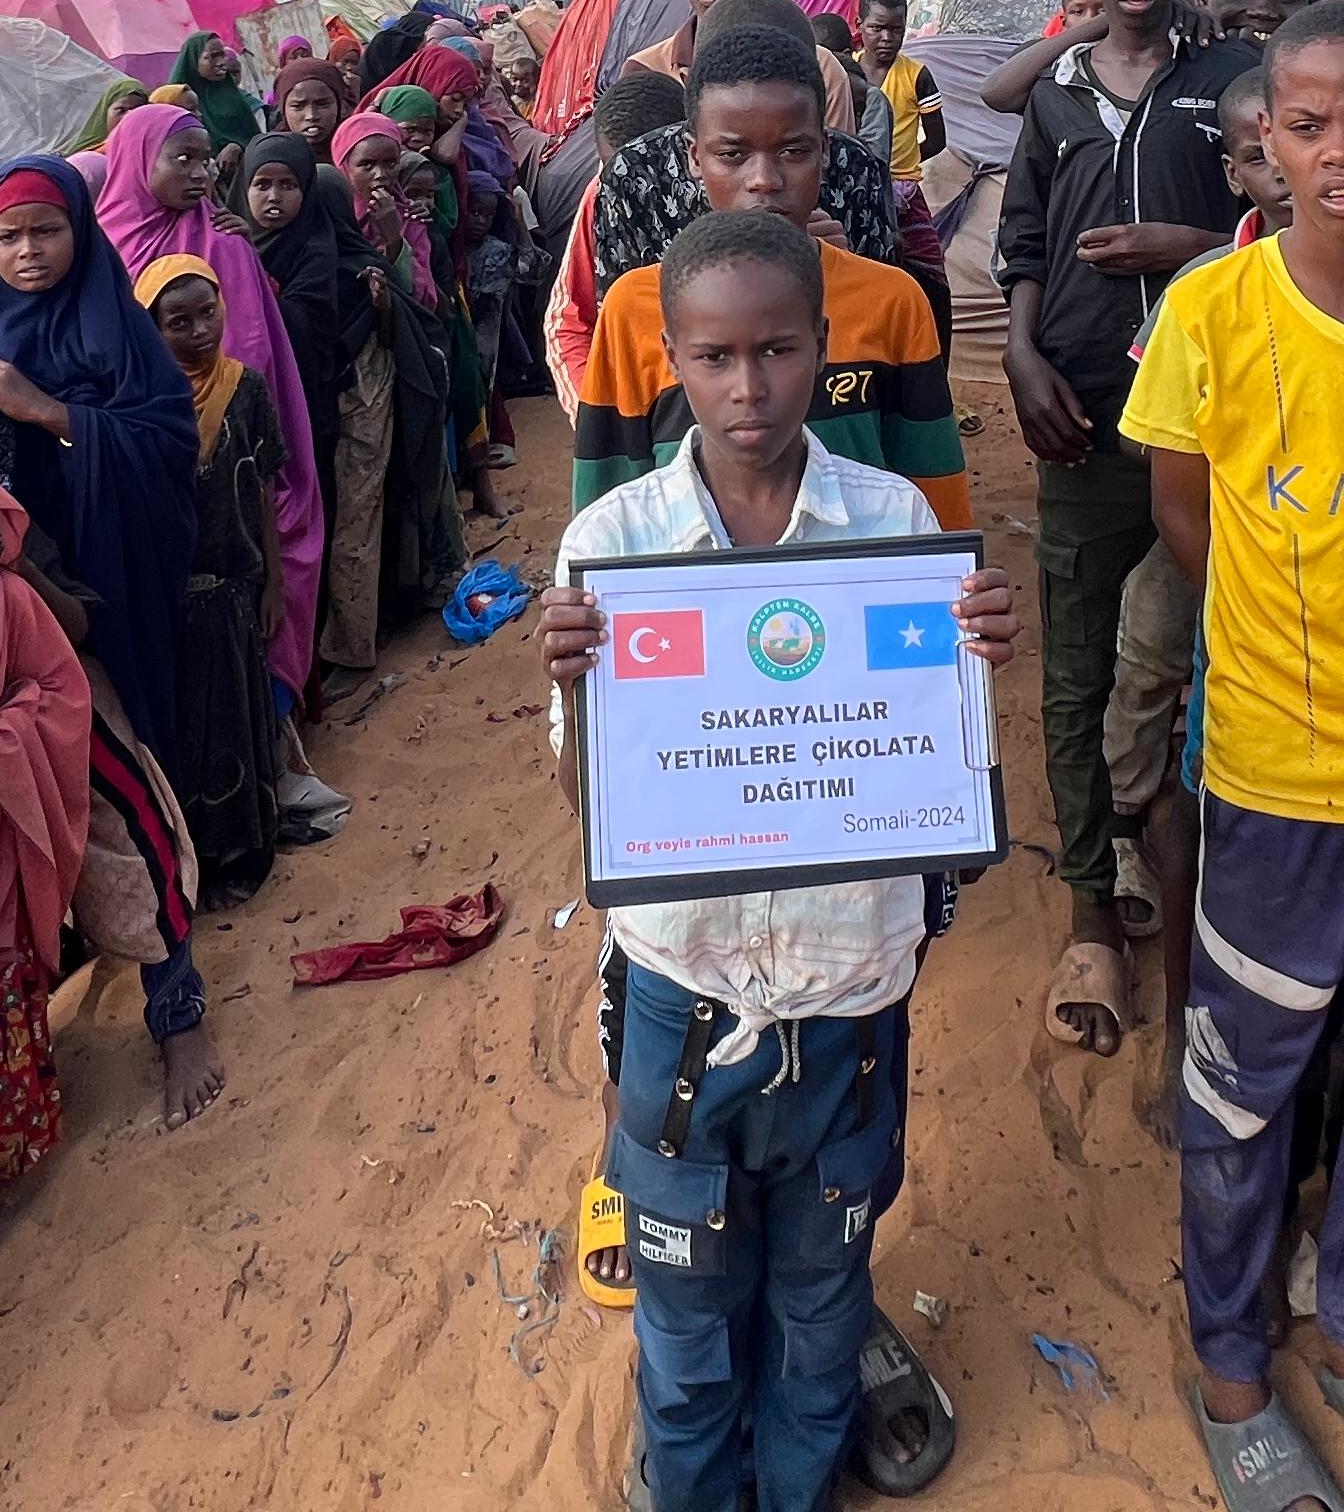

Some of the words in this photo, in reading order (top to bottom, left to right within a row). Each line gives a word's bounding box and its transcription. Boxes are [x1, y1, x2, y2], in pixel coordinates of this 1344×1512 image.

[701, 701, 888, 730] SAKARYALILAR
[657, 743, 797, 771] YETİMLERE
[812, 735, 936, 767] ÇİKOLATA
[743, 776, 855, 804] DAĞITIMI
[843, 805, 966, 833] Somali-2024
[740, 832, 789, 845] hassan
[591, 1194, 622, 1220] SMI
[641, 1218, 689, 1243] TOMMY
[641, 1245, 689, 1265] HILFIGER
